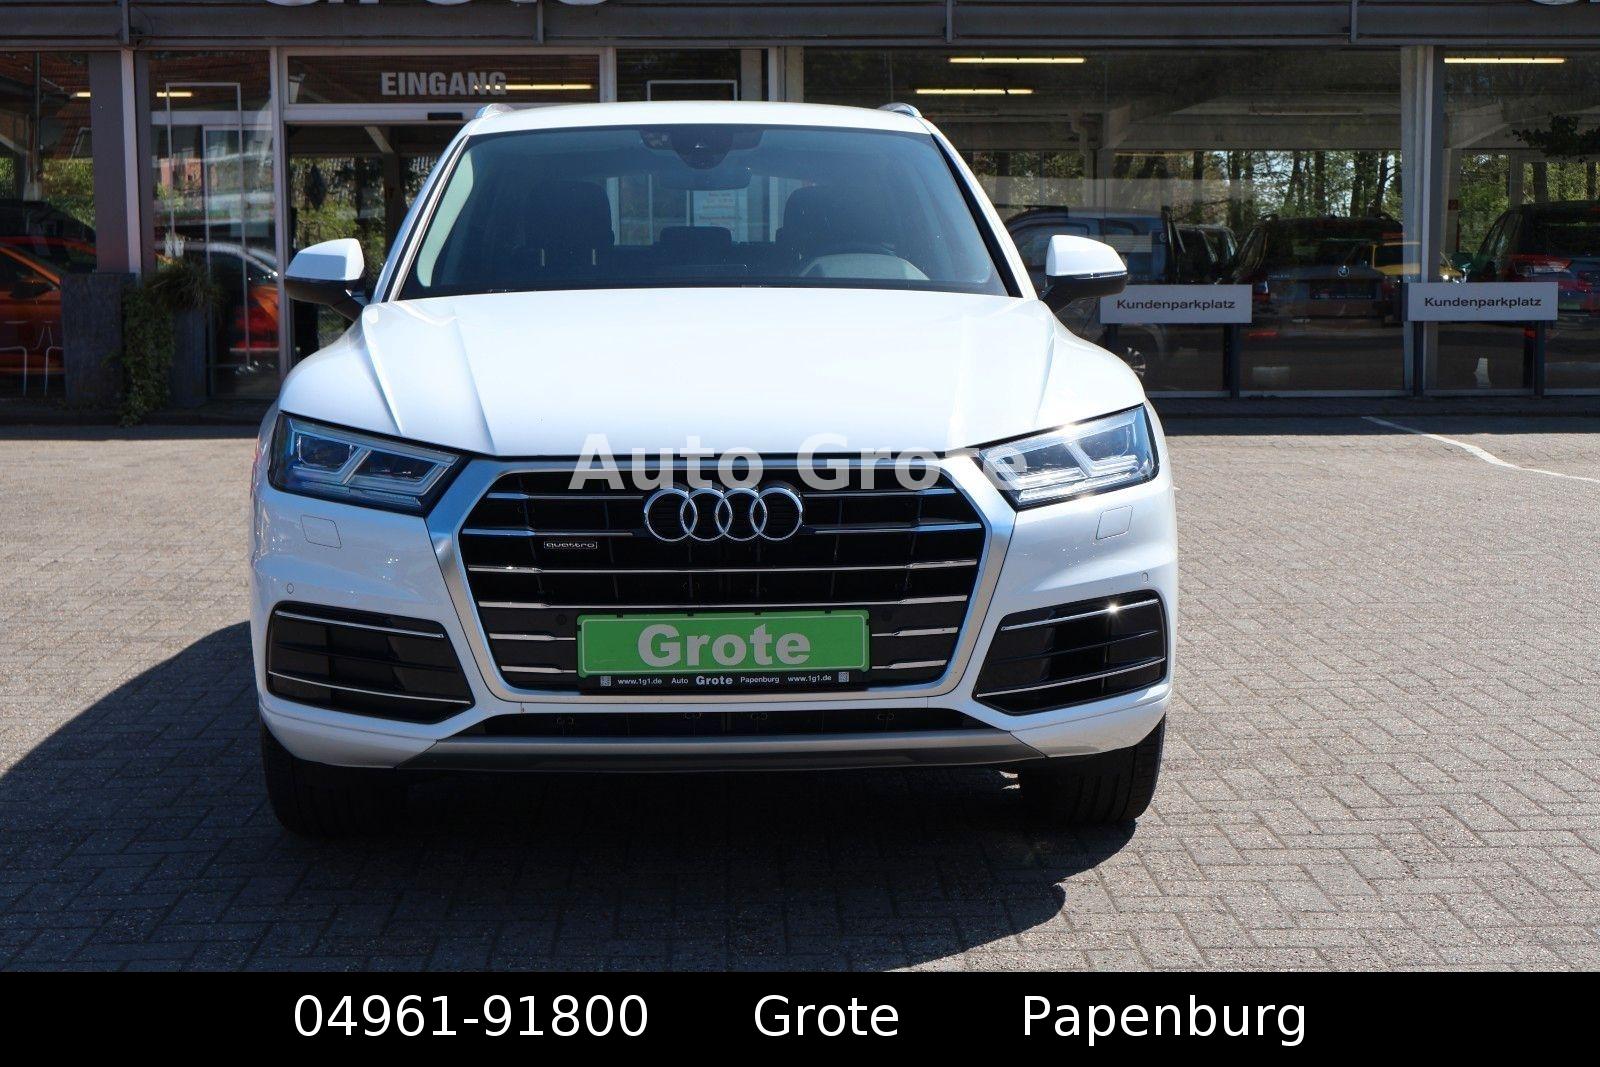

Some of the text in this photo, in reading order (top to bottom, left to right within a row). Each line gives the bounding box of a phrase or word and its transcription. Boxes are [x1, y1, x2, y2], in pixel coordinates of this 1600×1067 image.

[381, 71, 507, 97] EINGANG
[1116, 297, 1237, 313] Kundenparkplatz
[1424, 295, 1543, 310] Kundenparkplatz
[545, 541, 597, 550] quattro
[637, 623, 811, 667] Grote
[617, 675, 832, 686] www.1g1.de Auto Grote Papenburg www.1g1.de
